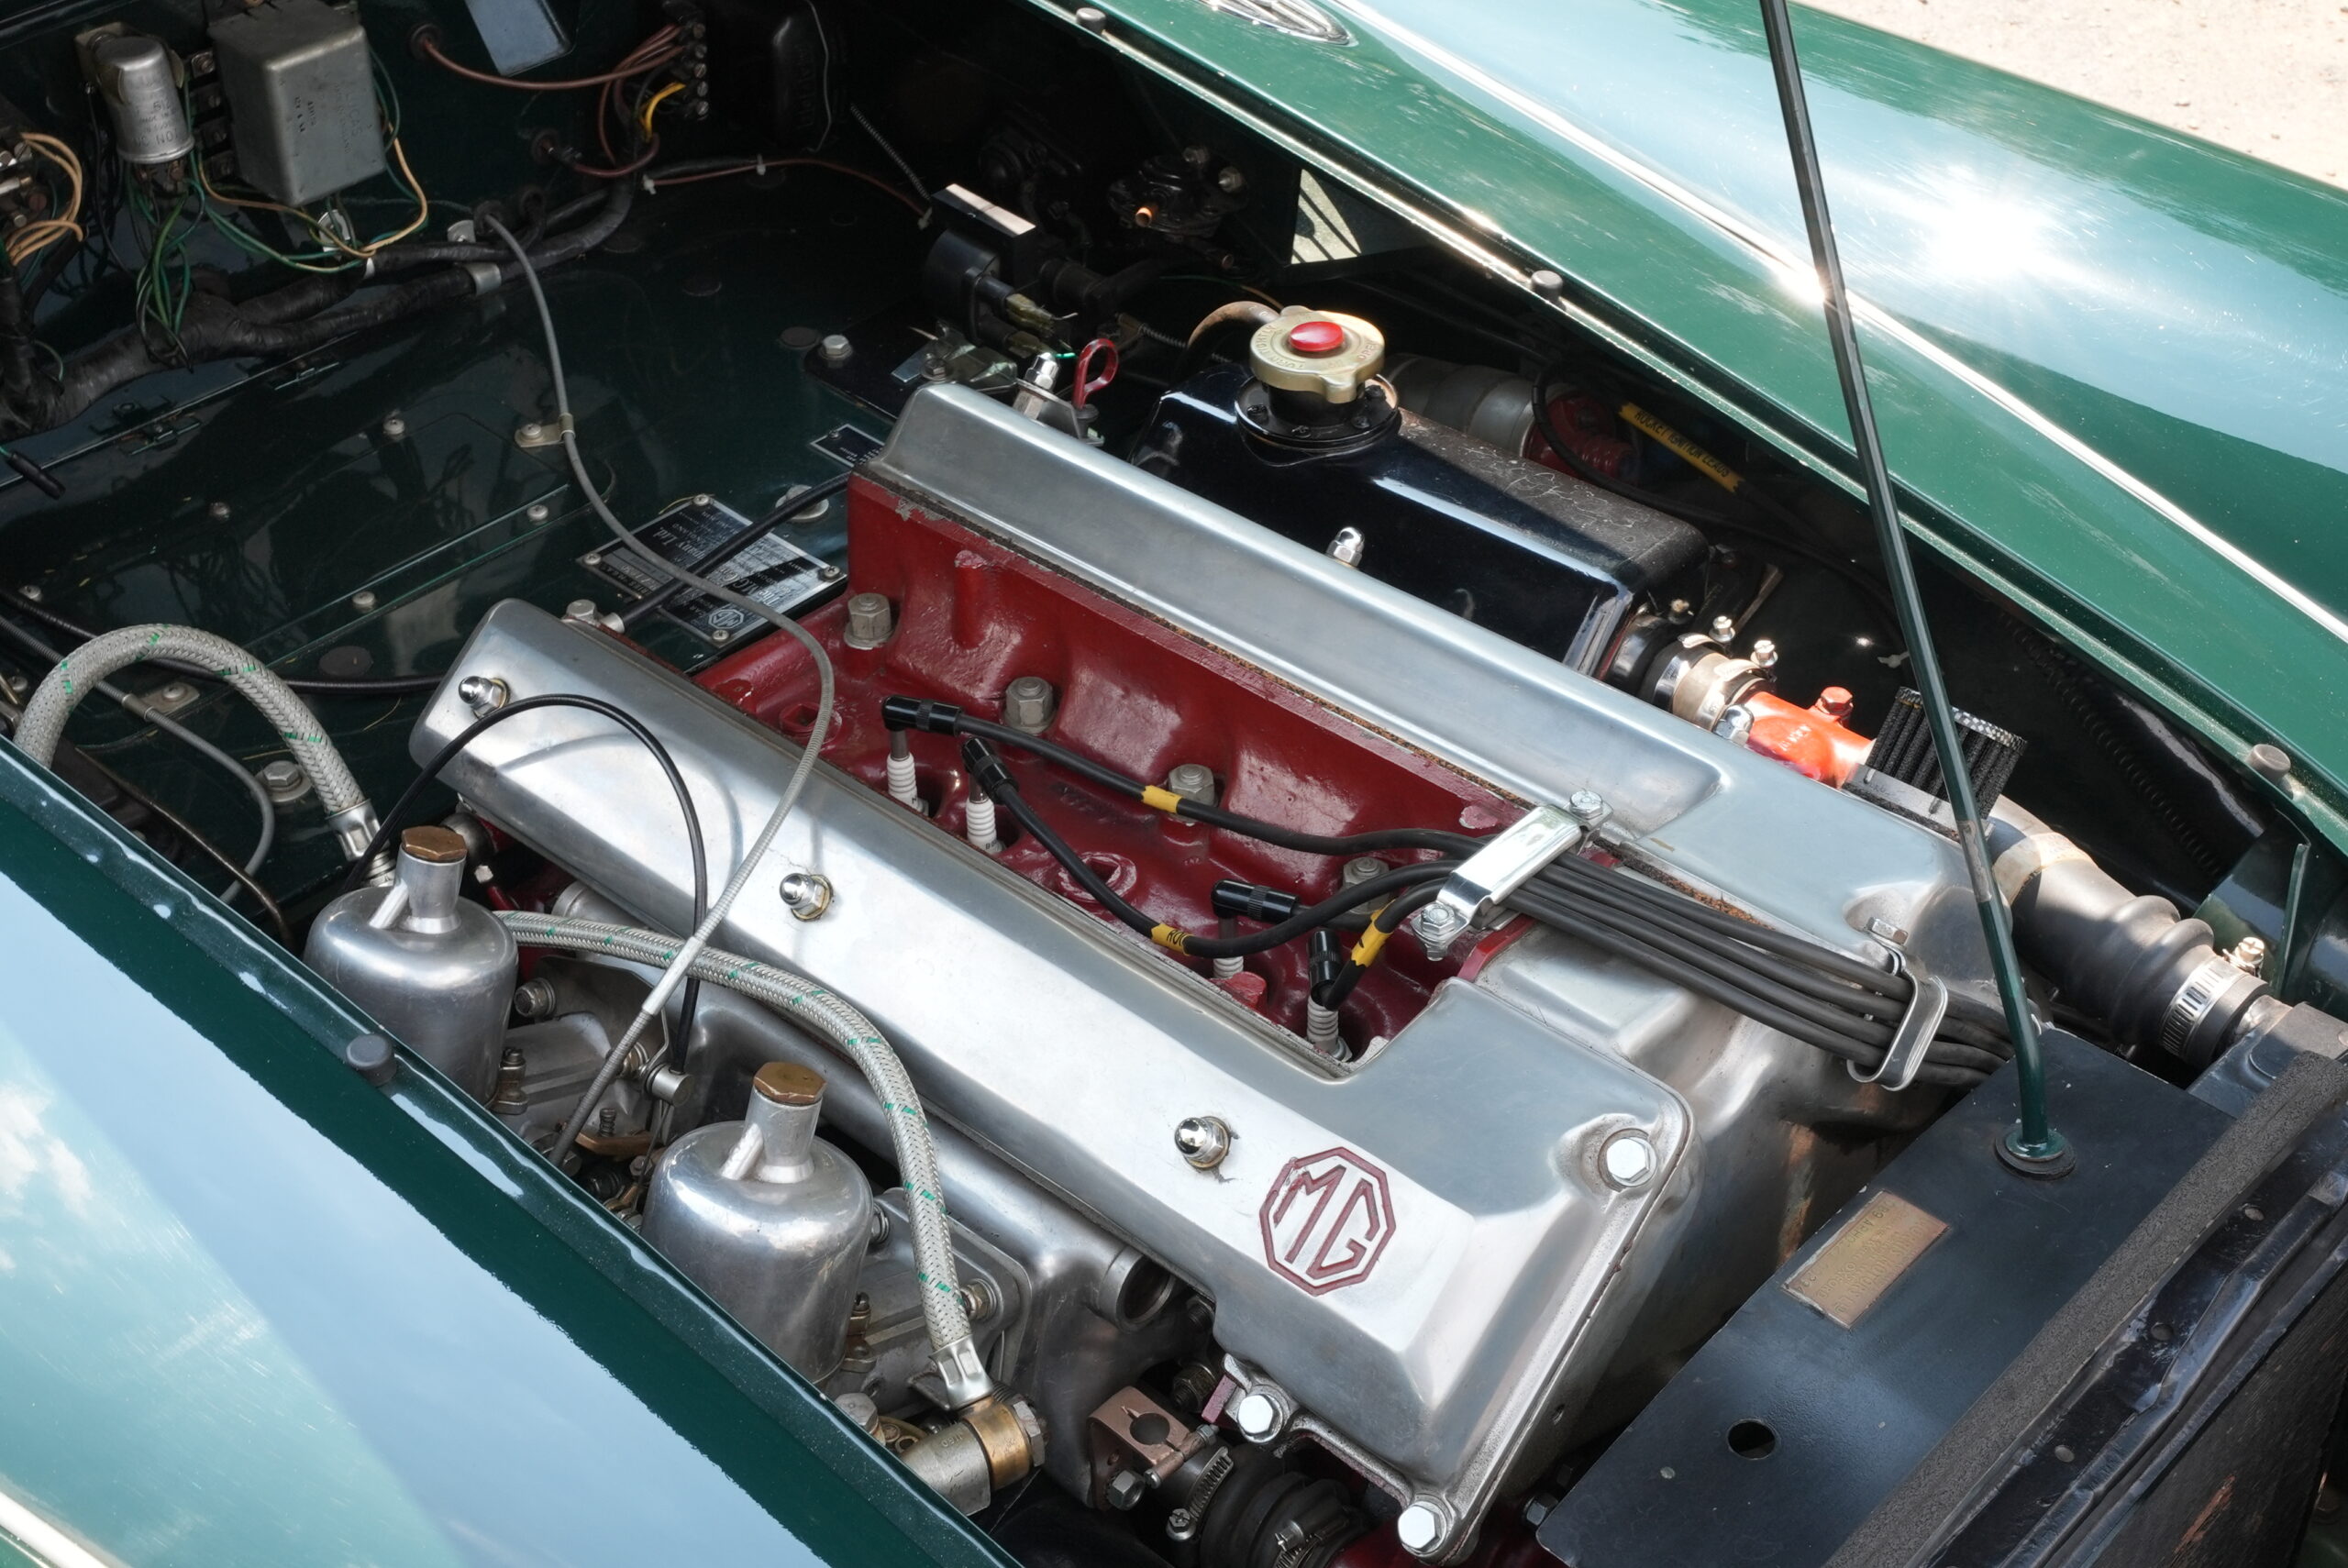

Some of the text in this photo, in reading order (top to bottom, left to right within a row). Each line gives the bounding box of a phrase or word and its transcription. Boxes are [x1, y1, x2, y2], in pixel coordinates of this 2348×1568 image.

[758, 587, 781, 606] The
[711, 610, 739, 628] MG
[1268, 1159, 1386, 1284] MG
[1816, 1261, 1857, 1300] OXFORD
[1850, 1256, 1896, 1298] MOTORS
